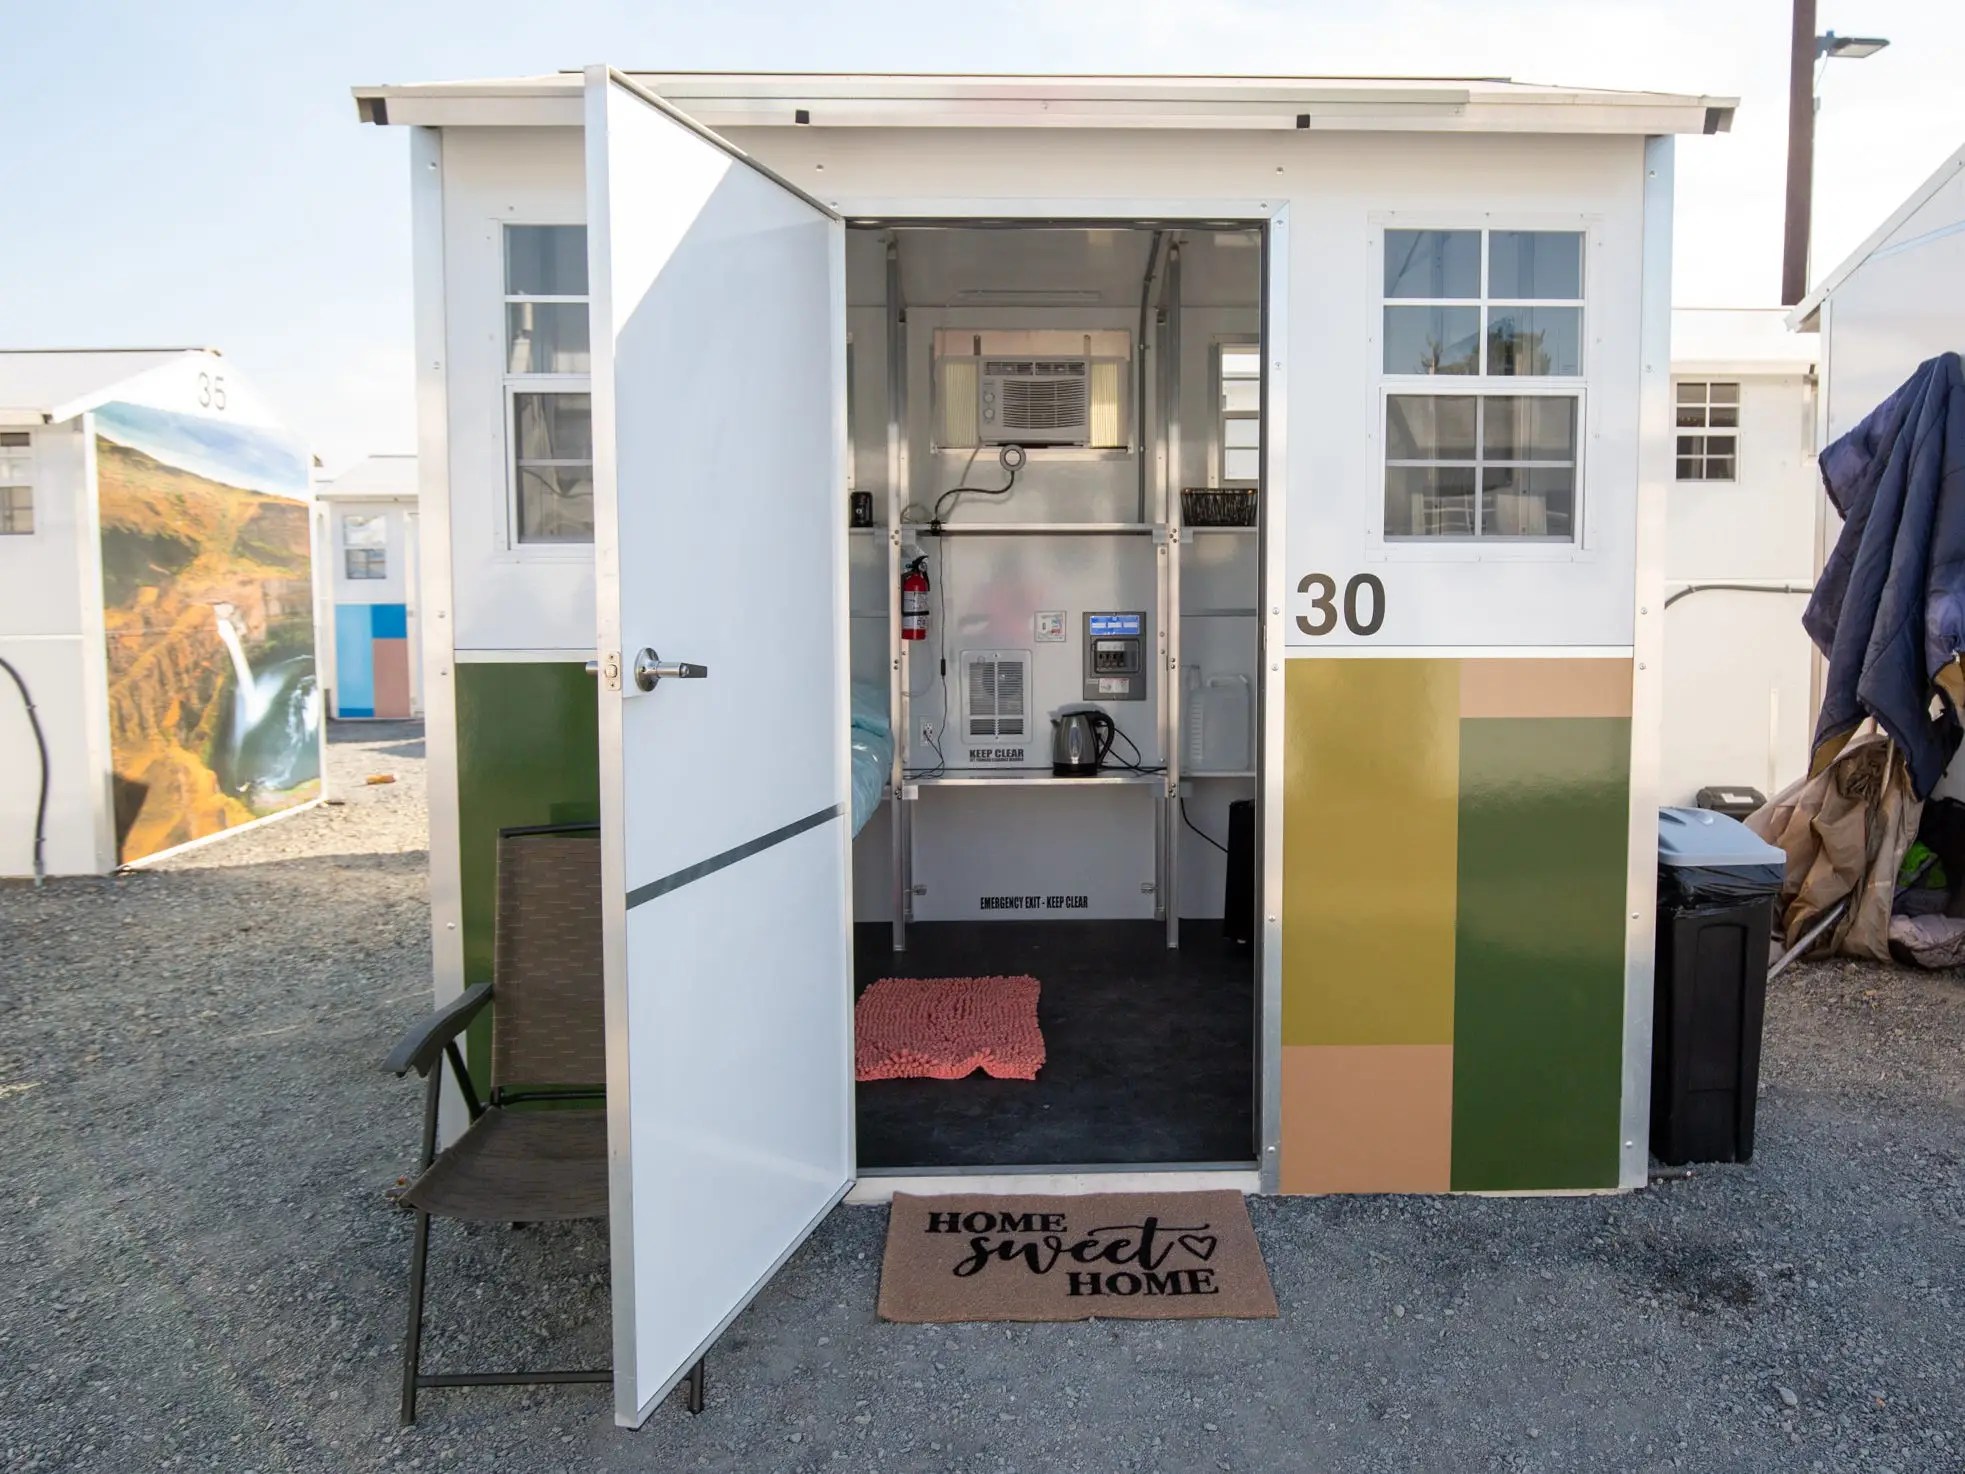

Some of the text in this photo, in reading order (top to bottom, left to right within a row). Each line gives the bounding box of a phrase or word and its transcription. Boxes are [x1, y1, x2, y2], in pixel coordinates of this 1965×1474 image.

[199, 371, 226, 411] 35
[1295, 573, 1386, 636] 30
[970, 749, 1024, 758] KEEP CLEAR
[980, 896, 1024, 909] EMERGENCY
[1025, 896, 1041, 909] EXIT
[1046, 896, 1064, 909] KEEP
[1065, 896, 1088, 909] CLEAR
[925, 1212, 1068, 1233] HOME
[953, 1217, 1210, 1277] sweet
[1066, 1269, 1219, 1296] HOME
